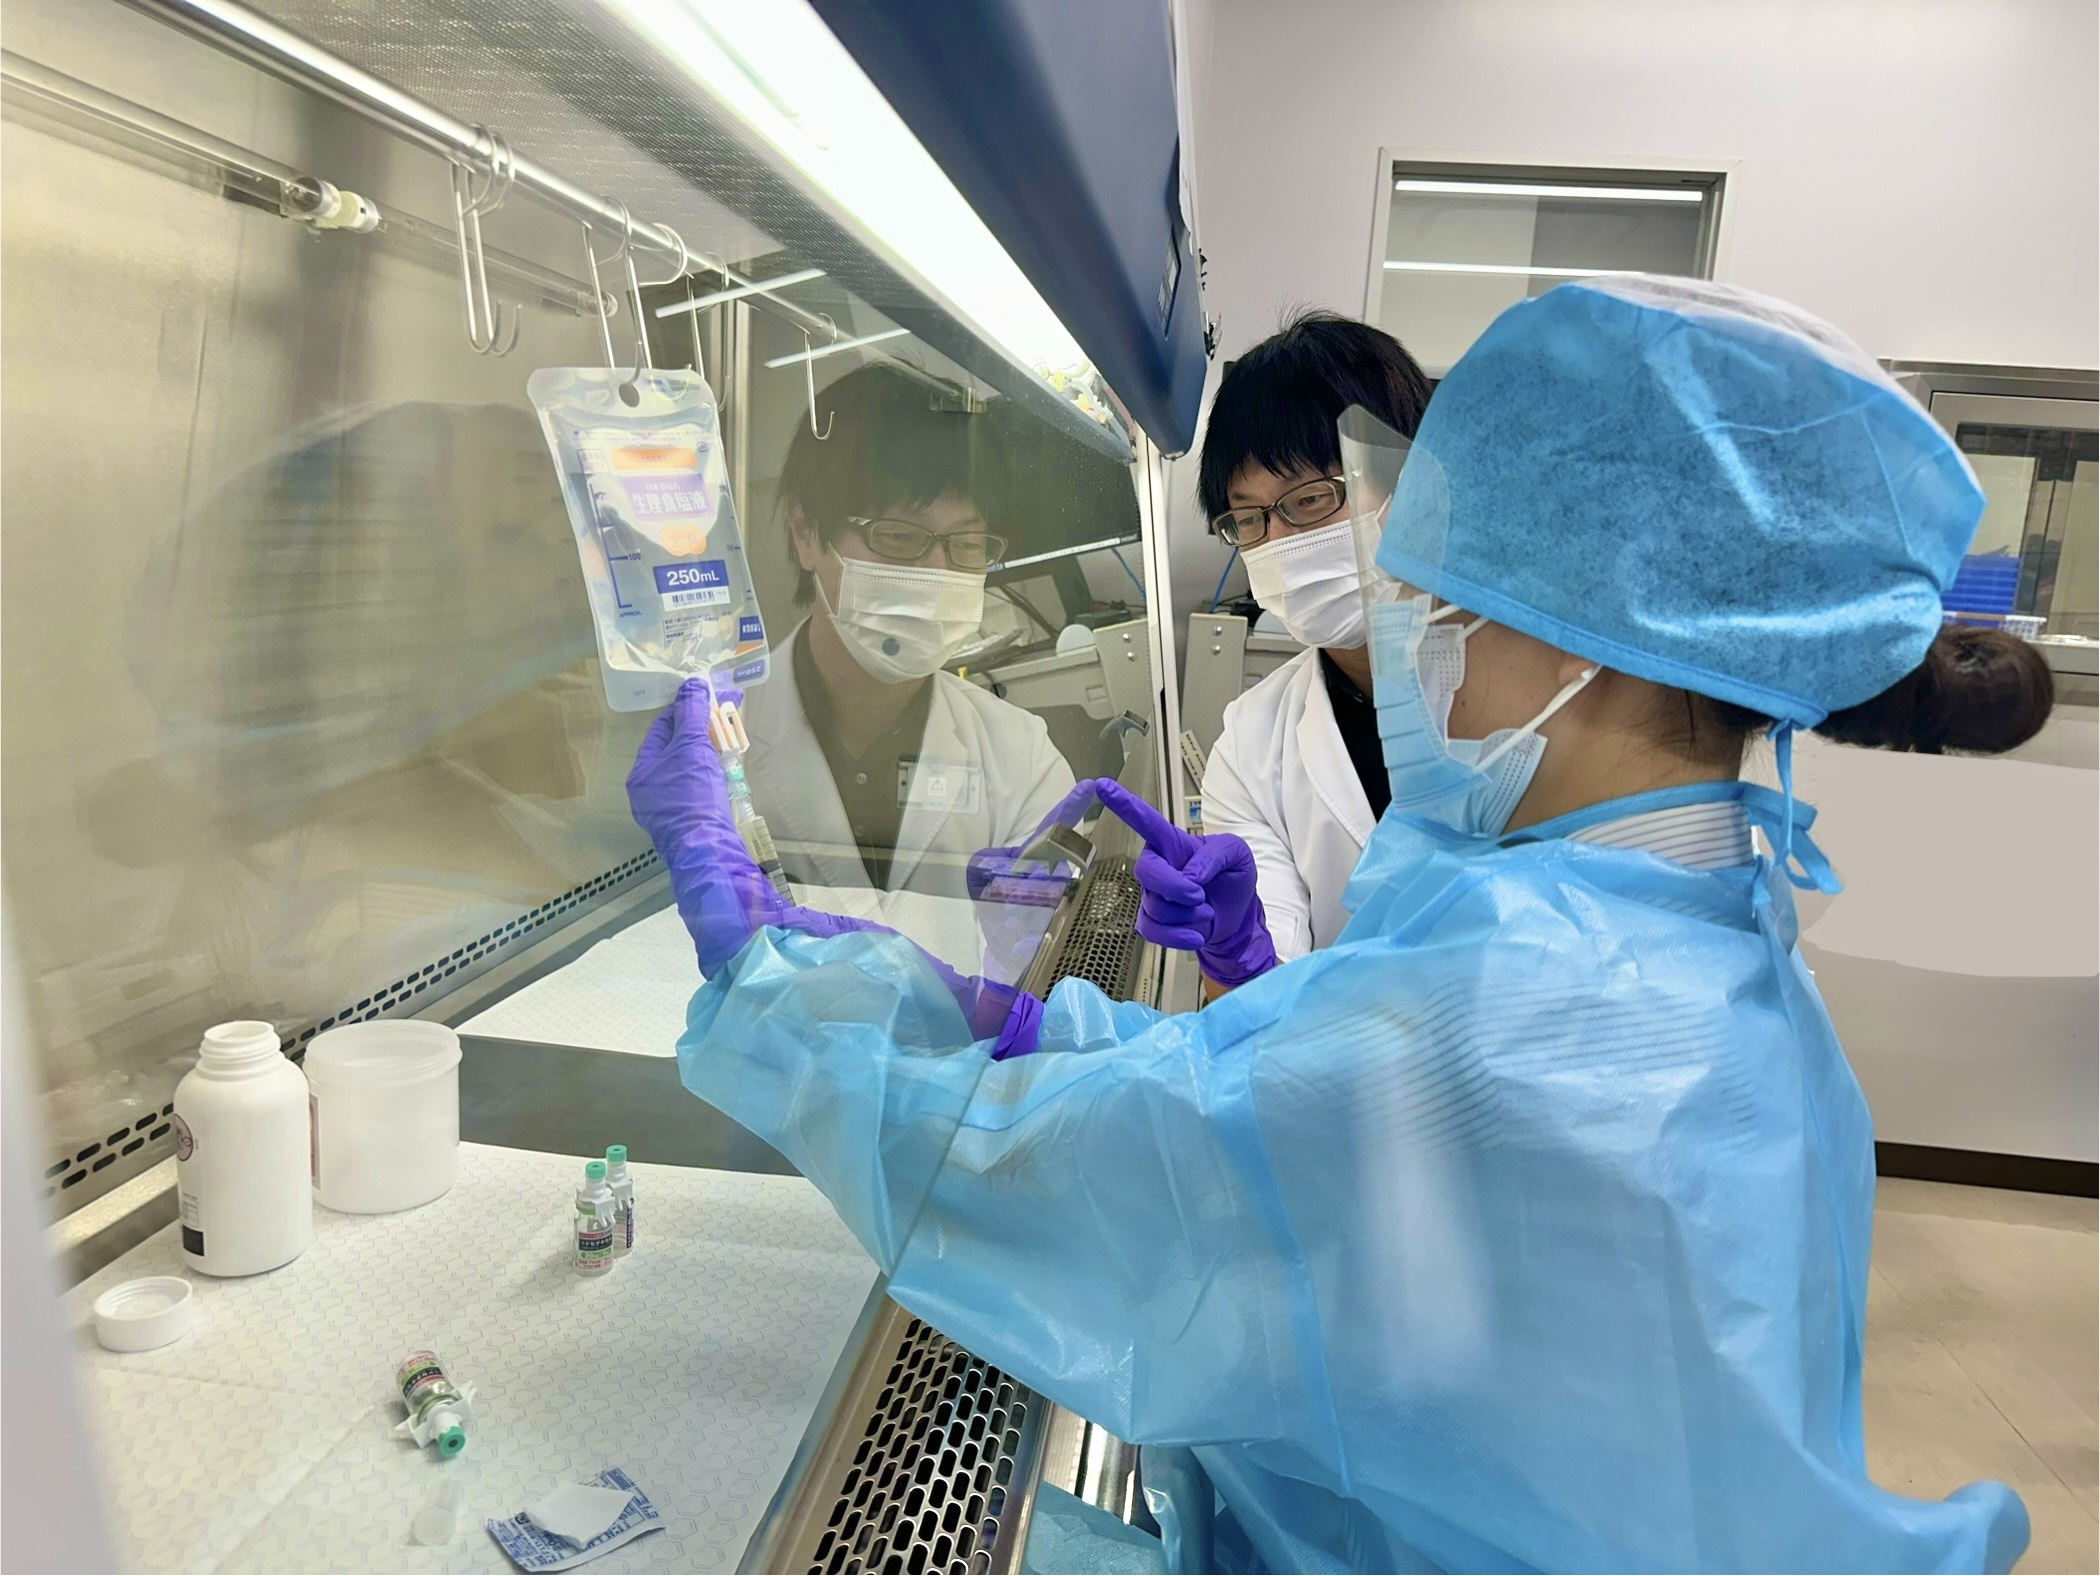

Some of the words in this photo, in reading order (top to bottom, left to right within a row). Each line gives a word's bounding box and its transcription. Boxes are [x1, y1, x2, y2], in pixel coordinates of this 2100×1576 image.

[632, 490, 708, 514] 生理食塩液
[628, 552, 641, 561] 100
[666, 568, 720, 587] 250mL
